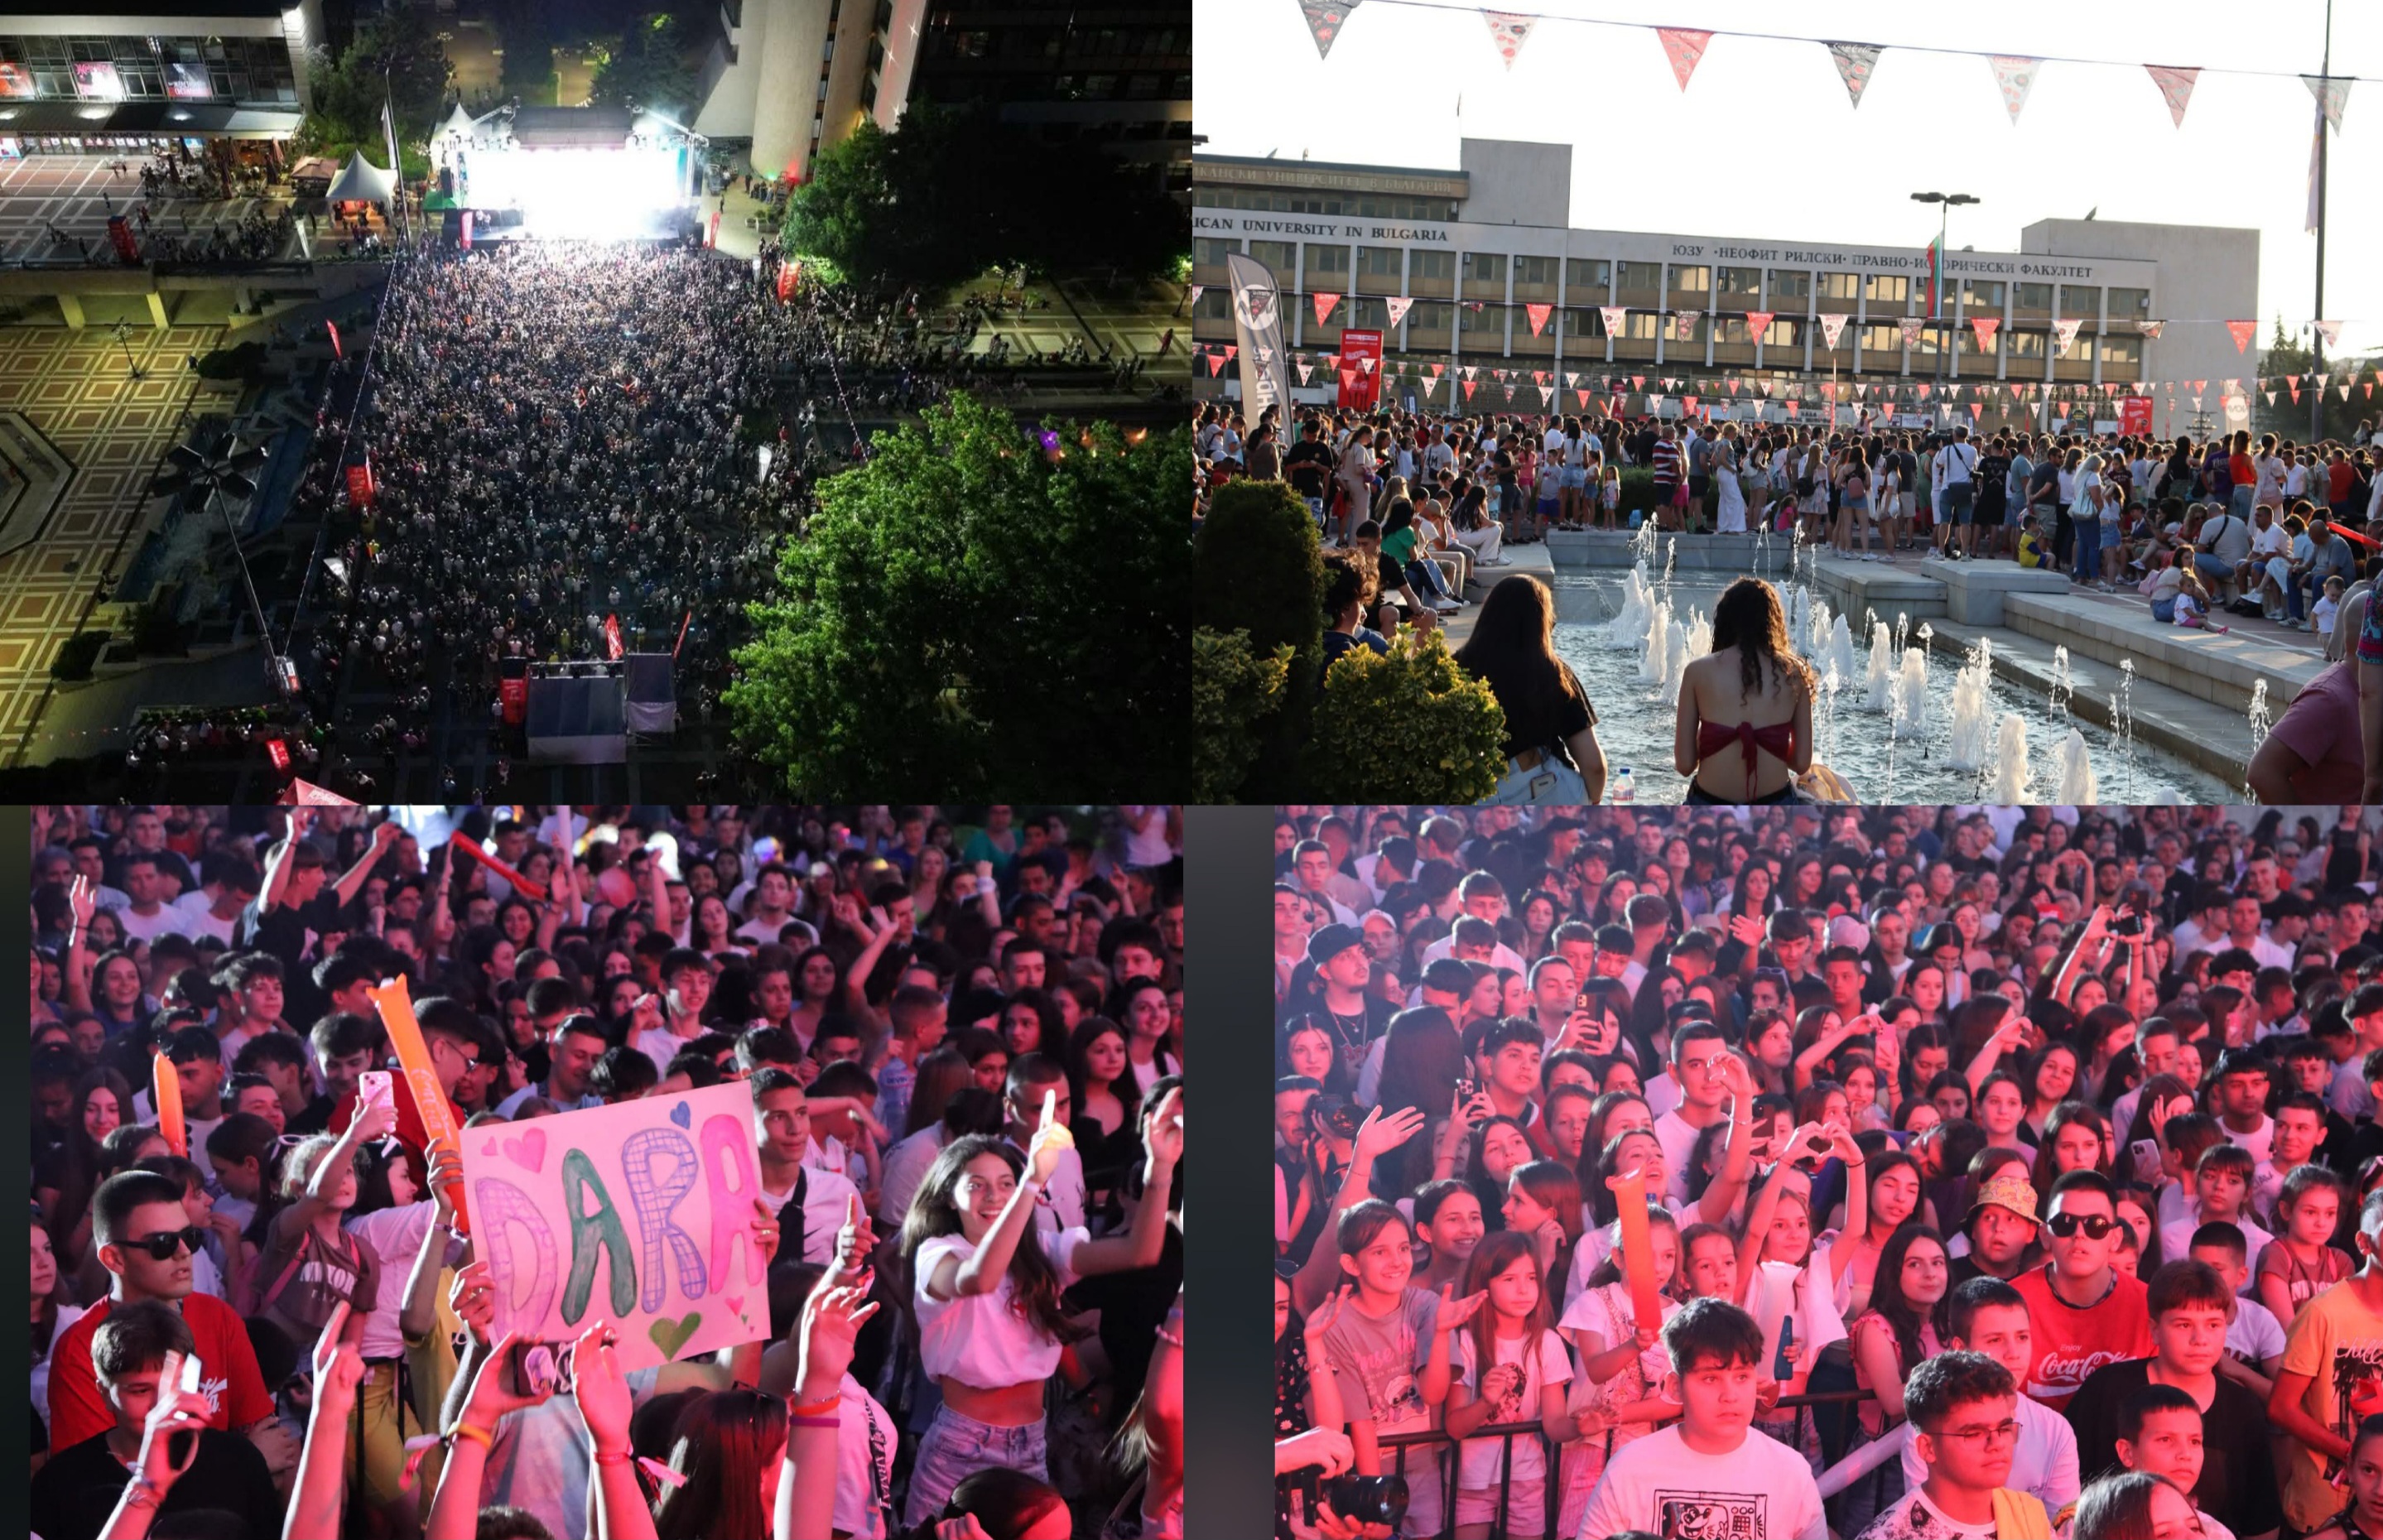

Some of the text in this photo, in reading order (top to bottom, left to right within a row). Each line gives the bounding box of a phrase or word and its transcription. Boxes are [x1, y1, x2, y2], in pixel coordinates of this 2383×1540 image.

[1265, 171, 1360, 186] УНИВЕРСИТЕТ
[1370, 178, 1377, 187] В
[1385, 179, 1451, 193] БЪЛГАРИЯ
[1192, 217, 1448, 241] ICAN UNIVERSITY IN BULGARIA
[1672, 244, 1704, 257] ЮЗУ
[1851, 254, 2015, 274] ПРАВНО-ИСОРИЧЕСКИ
[2020, 263, 2092, 278] ФАКУЛТЕТ
[474, 1114, 766, 1342] DARA
[2038, 1351, 2137, 1382] Coca-C
